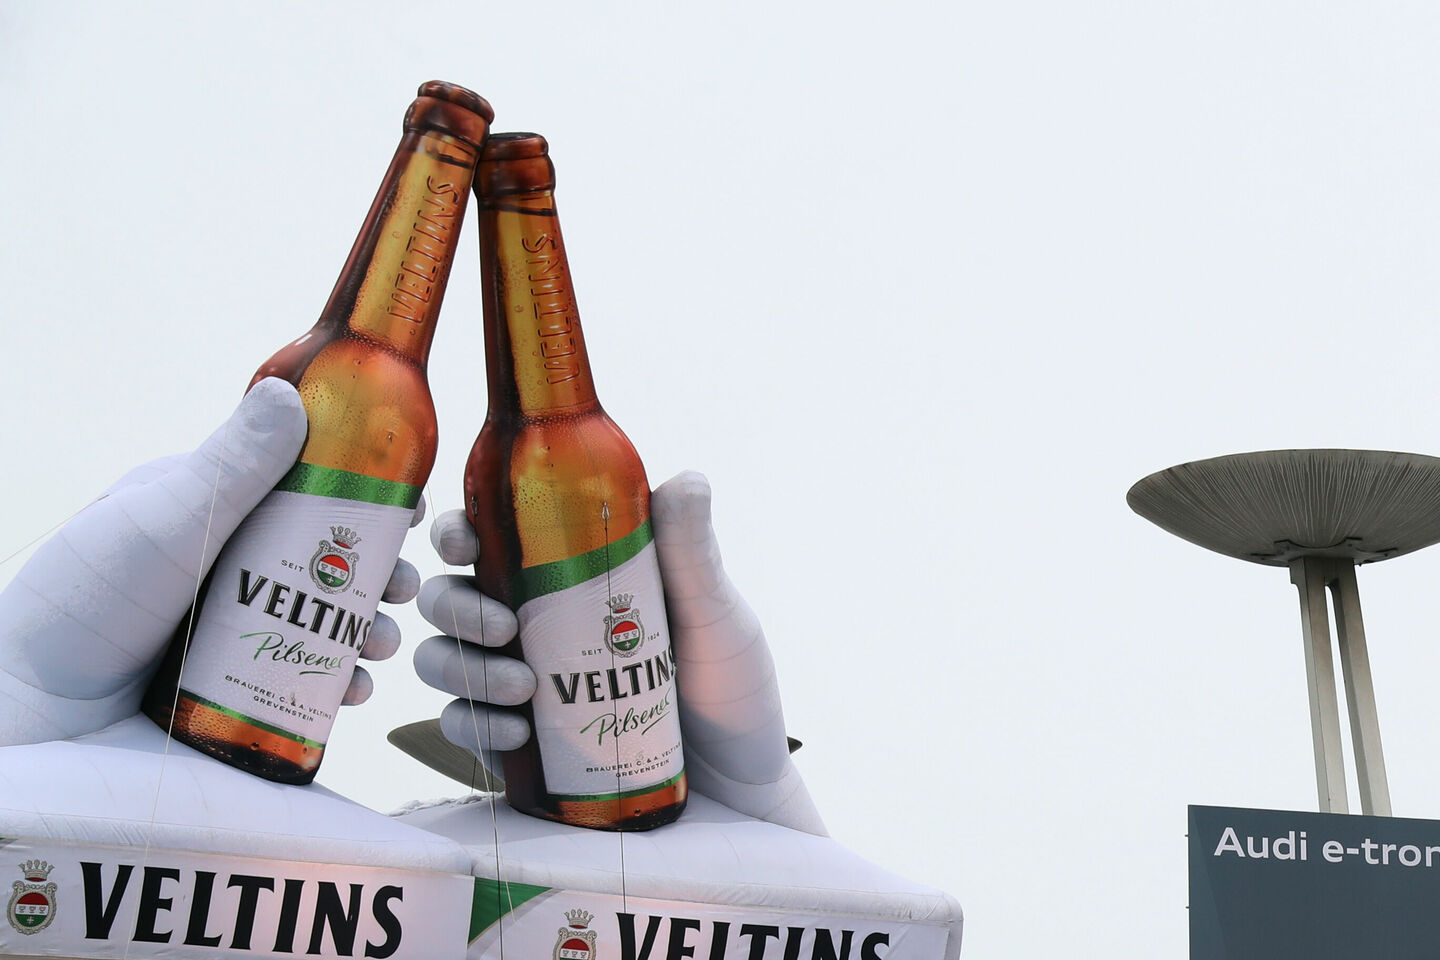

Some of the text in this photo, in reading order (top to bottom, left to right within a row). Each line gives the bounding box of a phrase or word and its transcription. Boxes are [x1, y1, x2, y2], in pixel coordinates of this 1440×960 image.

[387, 176, 459, 324] VELTINS
[521, 234, 580, 385] VELTINS
[281, 559, 304, 573] SEIT
[237, 568, 371, 651] VELTINS
[239, 631, 351, 671] Pilsener
[581, 648, 603, 657] SEIT
[225, 675, 275, 699] BRAUEREI
[253, 695, 314, 723] GREVENSTEIN
[580, 686, 672, 746] Pilsener
[586, 763, 633, 773] BRAUEREI
[615, 758, 670, 778] GREVENSTEIN
[1213, 827, 1307, 861] Audi
[81, 862, 403, 959] VELTINS
